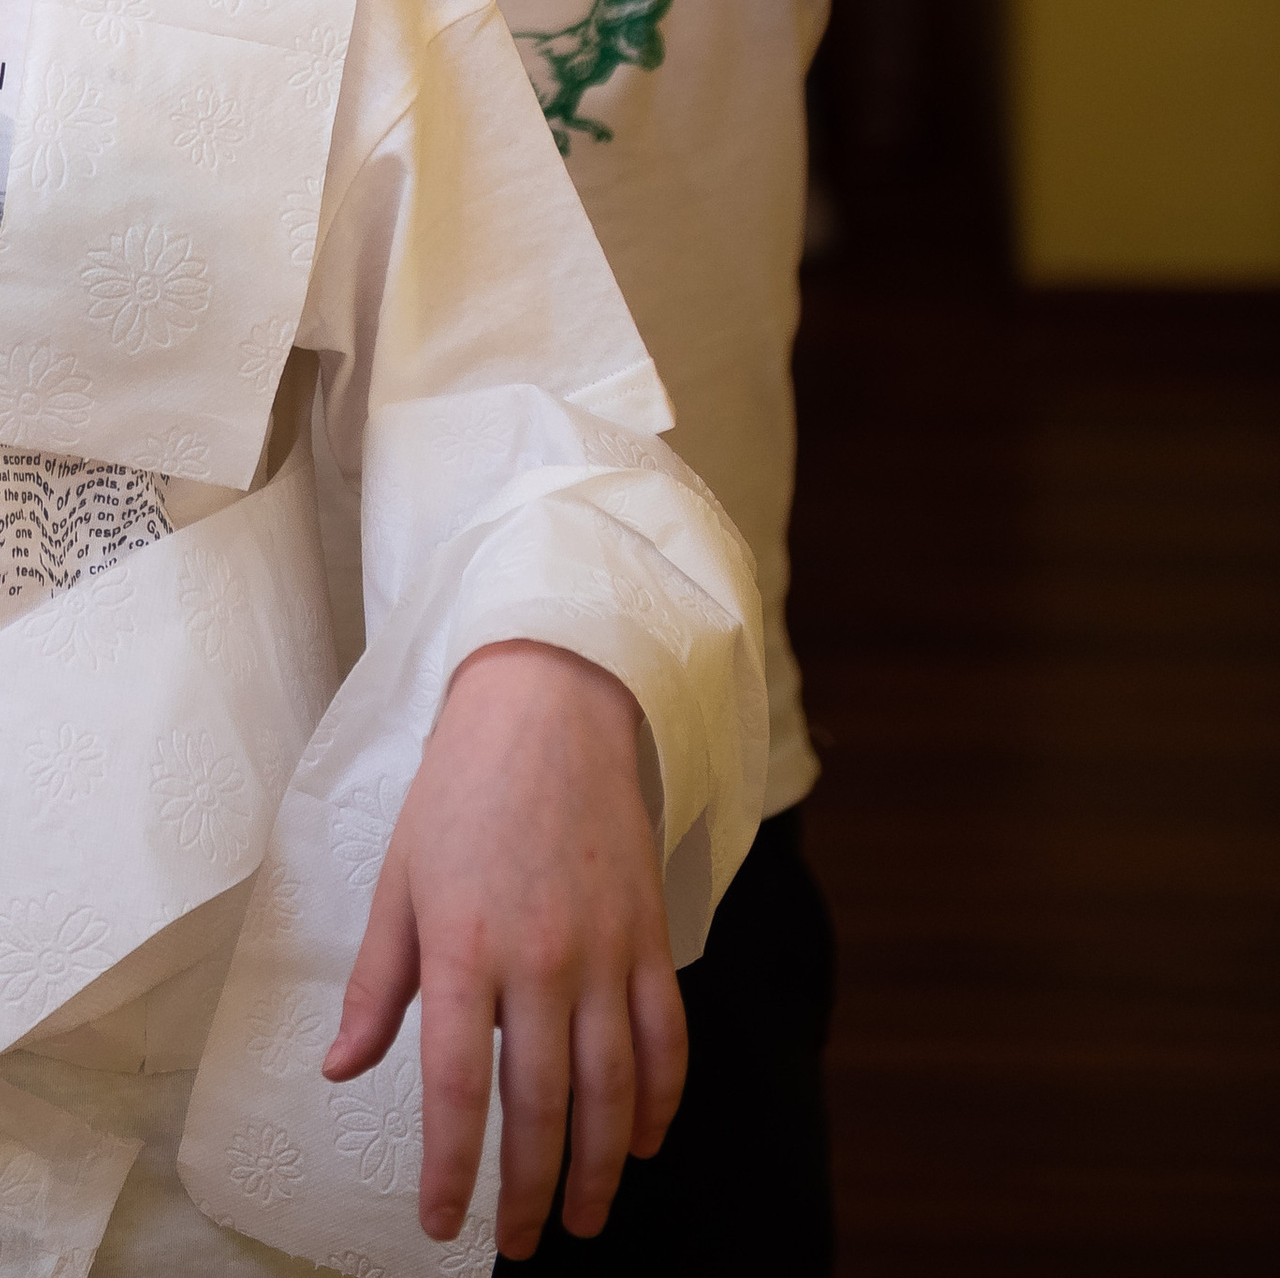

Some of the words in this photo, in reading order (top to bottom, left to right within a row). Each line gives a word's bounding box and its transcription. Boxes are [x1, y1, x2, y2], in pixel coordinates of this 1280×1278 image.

[3, 453, 41, 466] scored
[45, 458, 57, 476] of
[4, 488, 19, 502] the
[13, 471, 54, 501] number
[57, 487, 71, 511] of
[97, 511, 114, 522] on
[15, 528, 33, 539] one
[12, 545, 29, 558] the
[76, 543, 89, 559] of
[16, 565, 45, 586] team
[8, 585, 23, 596] or
